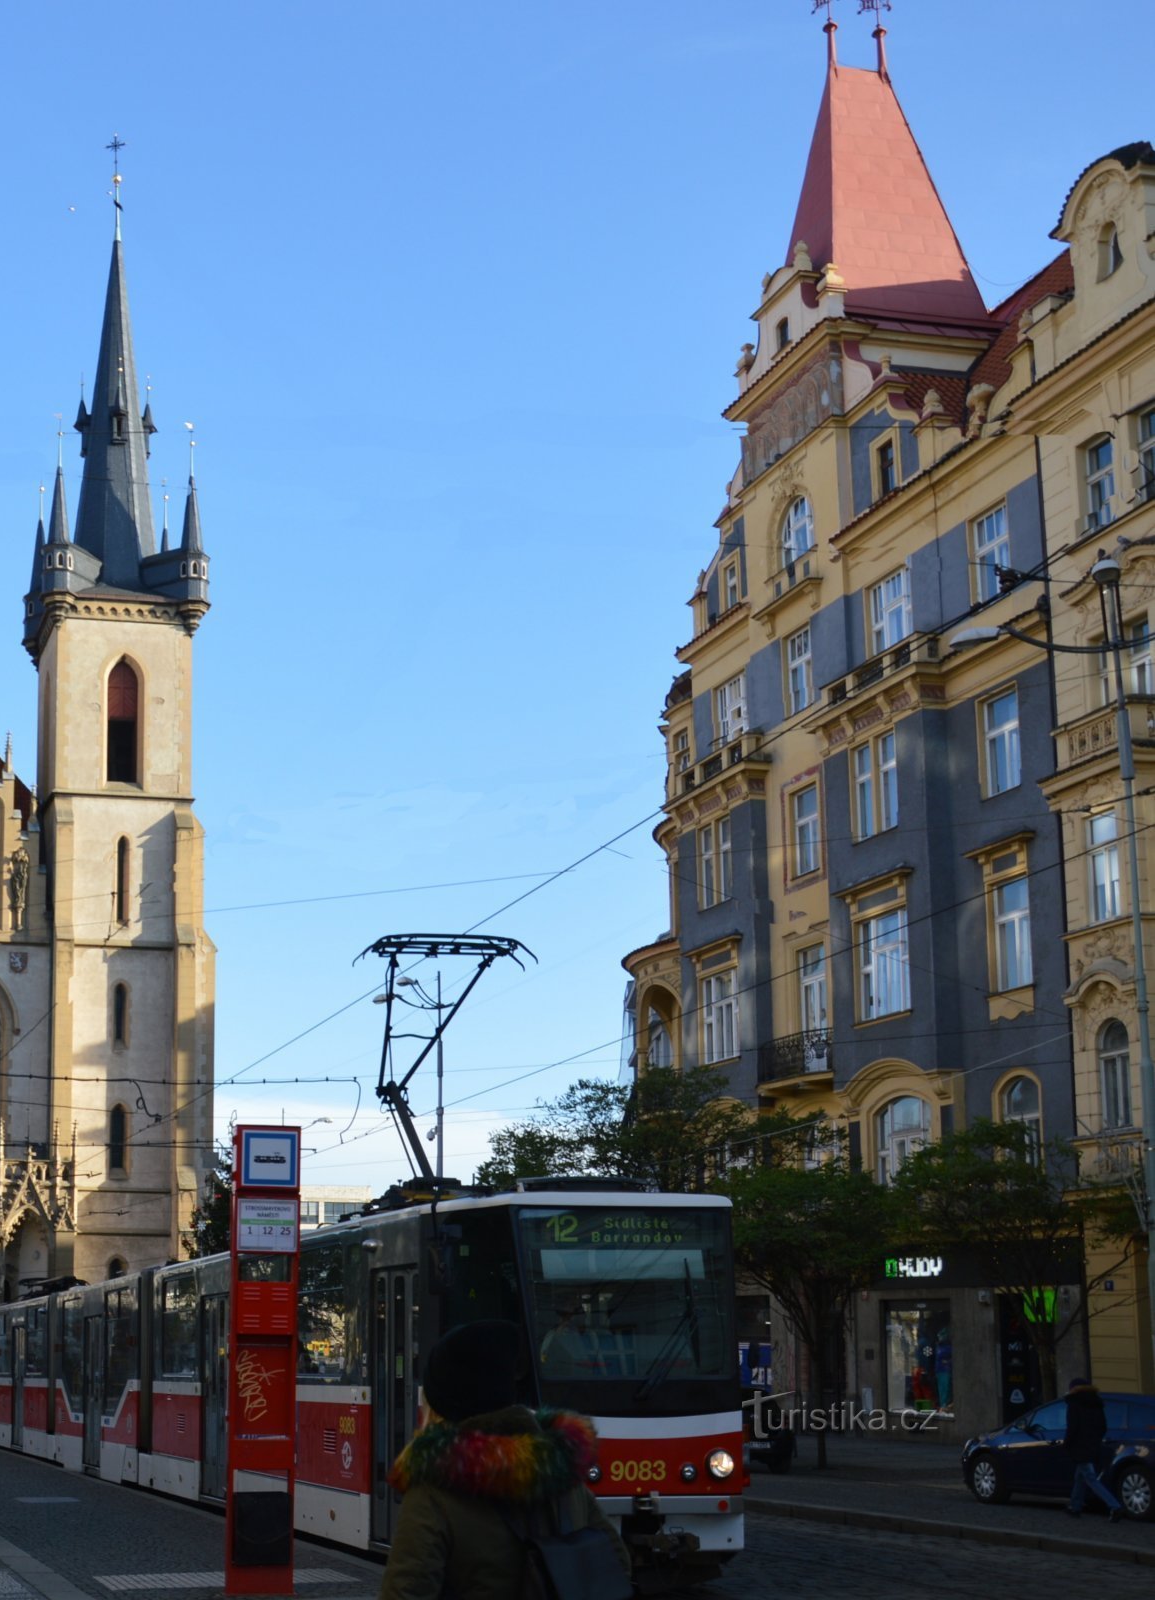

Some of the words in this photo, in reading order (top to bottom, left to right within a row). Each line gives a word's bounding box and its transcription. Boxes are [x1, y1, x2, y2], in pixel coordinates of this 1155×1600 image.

[247, 1226, 252, 1235] 1
[262, 1226, 273, 1235] 12
[280, 1226, 291, 1236] 25
[546, 1215, 579, 1242] 12
[591, 1231, 683, 1243] Barrandov
[339, 1415, 356, 1435] 9083
[609, 1459, 667, 1482] 9083
